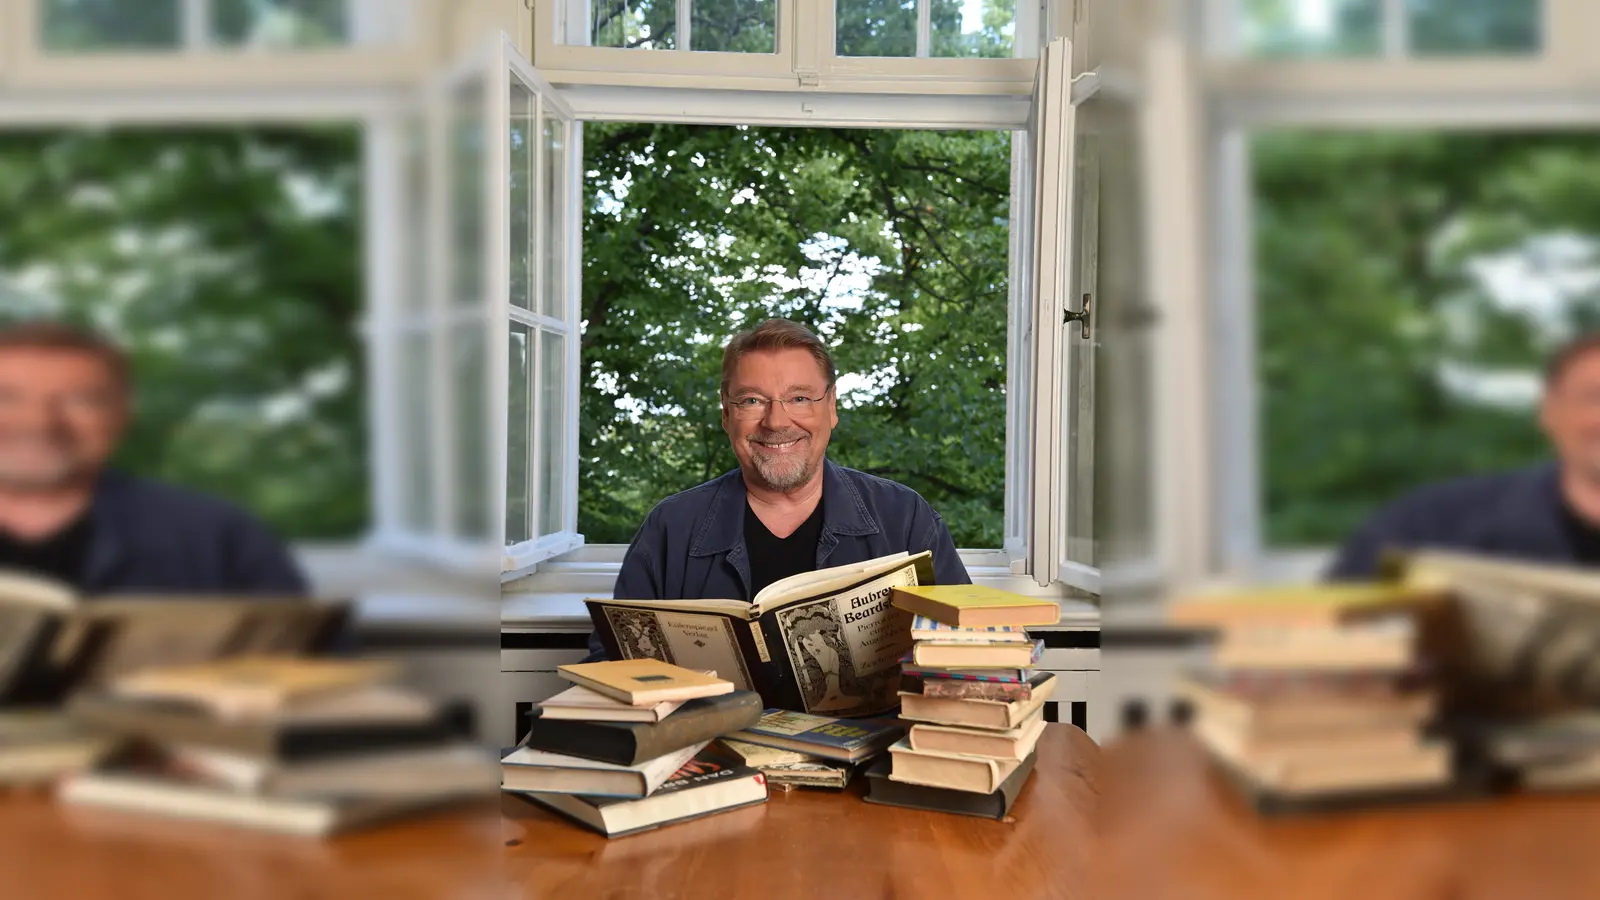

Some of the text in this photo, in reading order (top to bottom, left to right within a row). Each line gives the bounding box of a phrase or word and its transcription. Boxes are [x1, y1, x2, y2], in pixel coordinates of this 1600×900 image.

[844, 600, 893, 624] Beardsl
[667, 621, 718, 632] Eulenspiegel
[682, 629, 709, 639] Verlag
